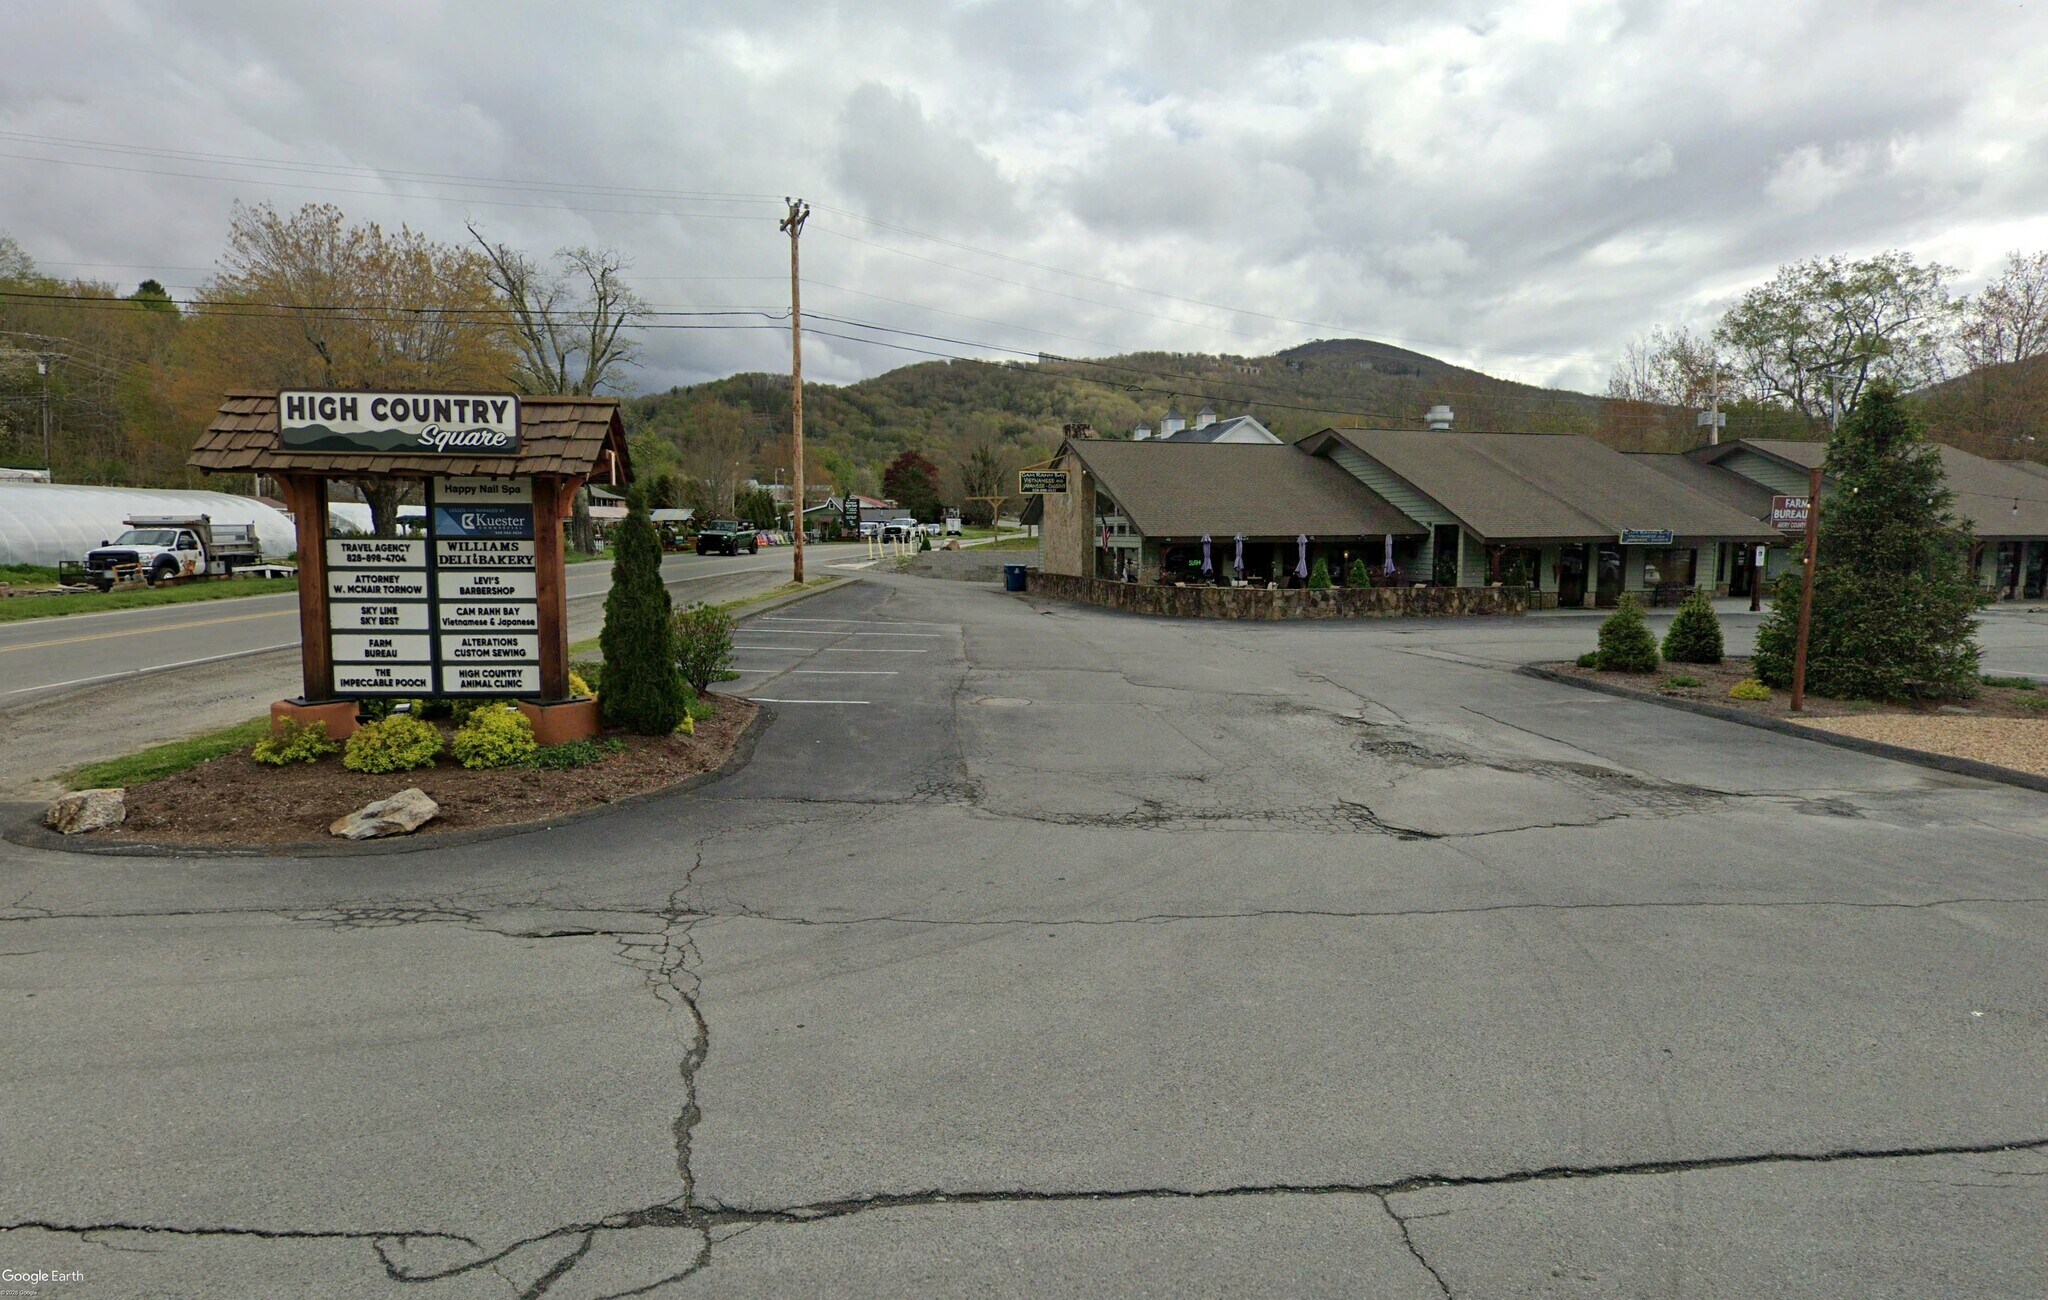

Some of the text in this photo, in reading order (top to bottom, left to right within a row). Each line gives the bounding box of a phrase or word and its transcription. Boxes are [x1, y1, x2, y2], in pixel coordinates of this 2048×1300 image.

[287, 396, 509, 424] HIGH COUNTRY
[417, 424, 508, 453] Square
[444, 485, 521, 495] Happy Nail Spa
[1785, 498, 1808, 508] FARM
[1774, 509, 1808, 519] BUREAU
[476, 513, 525, 526] Kuester
[341, 544, 411, 552] TRAVEL AGENCY
[447, 542, 519, 552] WILLIAMS
[346, 554, 407, 563] 828-898-4704
[355, 575, 400, 583] ATTORNEY
[473, 576, 500, 585] LEVI'S
[333, 585, 422, 594] W. MCNAIR TORNOW
[459, 587, 515, 595] BARBERSHOP
[361, 606, 398, 615] SKY LINE
[456, 607, 520, 616] CAM RANH BAY
[360, 617, 399, 625] SKY BEST
[442, 618, 535, 627] Vietnamese & Japanese
[369, 639, 392, 647] FARM
[461, 638, 518, 646] ALTERATIONS
[364, 649, 398, 657] BUREAU
[454, 649, 526, 657] CUSTOM SEWING
[375, 668, 391, 677] THE
[458, 669, 523, 678] HIGH COUNTRY
[340, 679, 427, 687] IMPECCABLE POOCH
[460, 680, 523, 688] ANIMAL CLINIC
